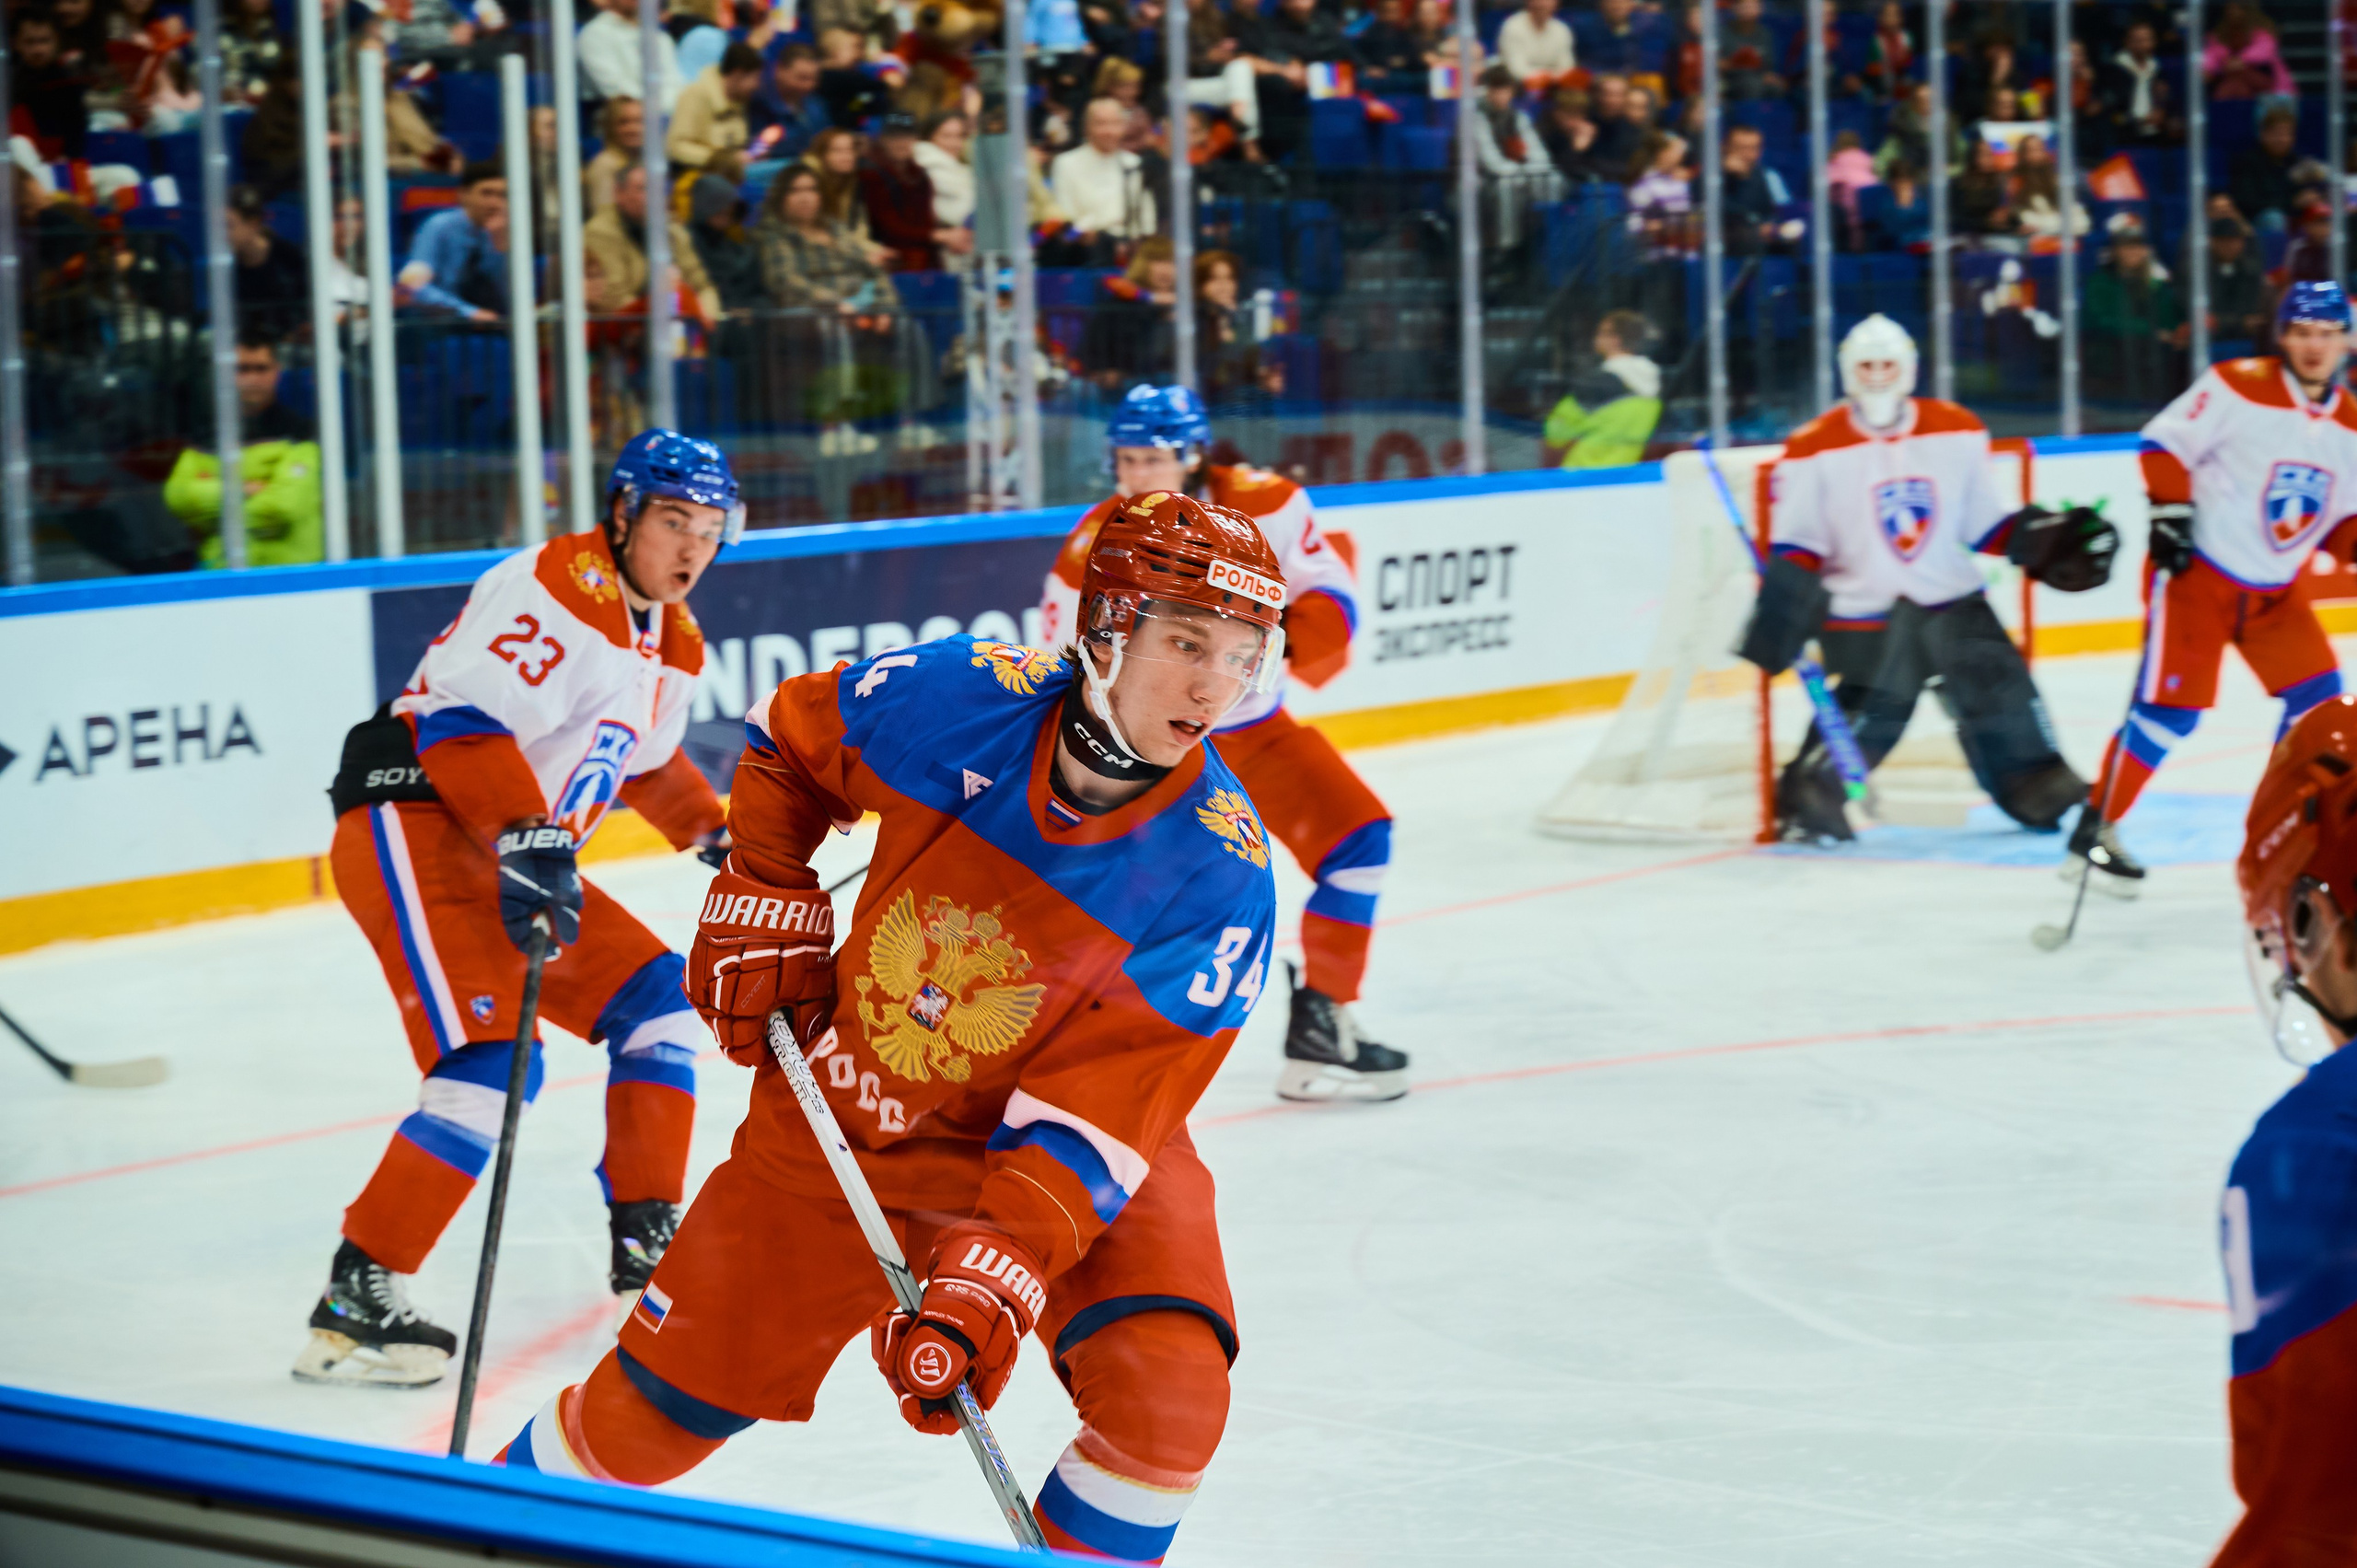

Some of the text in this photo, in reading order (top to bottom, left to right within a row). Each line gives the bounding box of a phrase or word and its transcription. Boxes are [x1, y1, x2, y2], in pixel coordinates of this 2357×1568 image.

[1212, 564, 1283, 602] РОЛЬФ
[1379, 546, 1517, 611] СПОРТ
[488, 614, 565, 687] 23
[1375, 614, 1511, 664] ЭКСПРЕСС
[854, 640, 923, 698] 4
[34, 702, 262, 783] АРЕНА
[1074, 722, 1134, 769] CCM
[366, 766, 432, 788] SOY
[498, 828, 574, 856] AUER
[701, 893, 835, 938] WARRIO
[1186, 925, 1269, 1013] 34
[772, 1016, 827, 1101] OYUZ
[807, 1025, 910, 1134] РОСС
[970, 1290, 992, 1308] PRO
